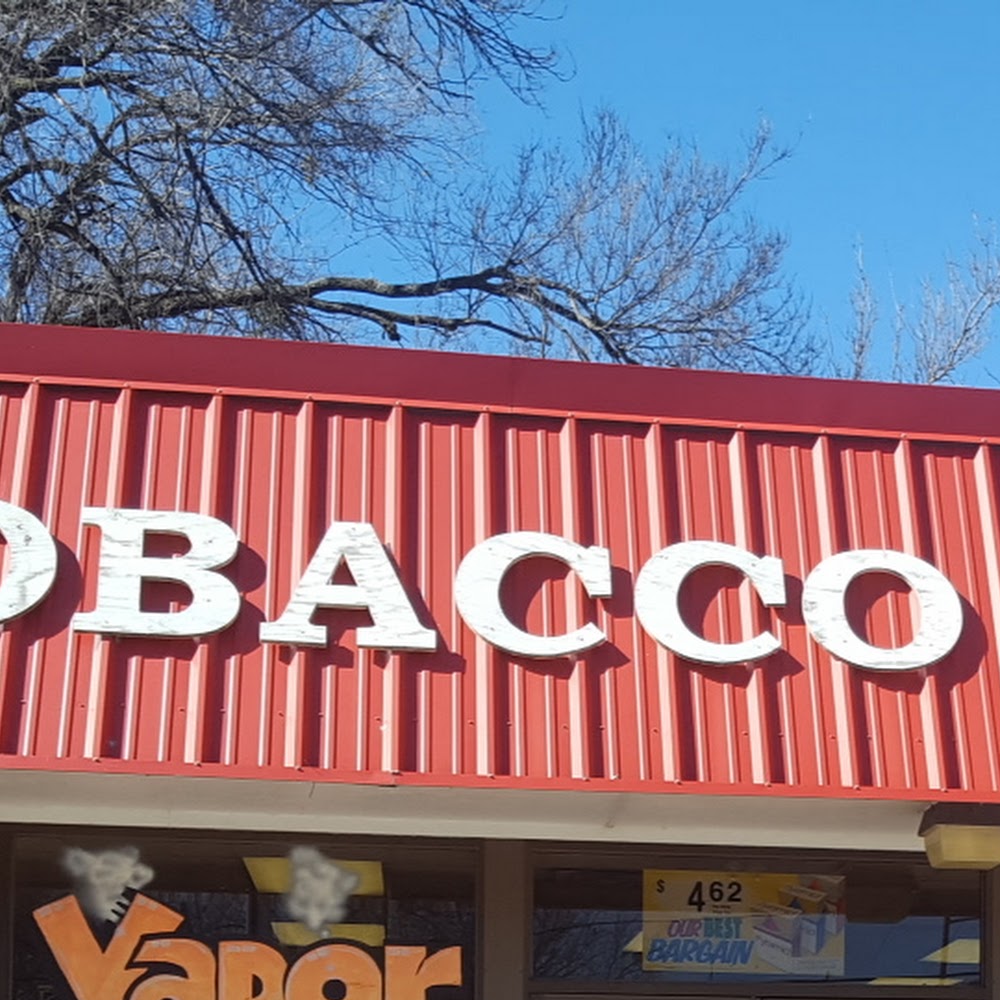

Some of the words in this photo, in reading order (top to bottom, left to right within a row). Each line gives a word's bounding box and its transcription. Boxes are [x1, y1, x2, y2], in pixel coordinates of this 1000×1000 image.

[667, 919, 700, 938] OUR
[703, 917, 743, 939] BEST
[647, 938, 754, 965] BARGAIN
